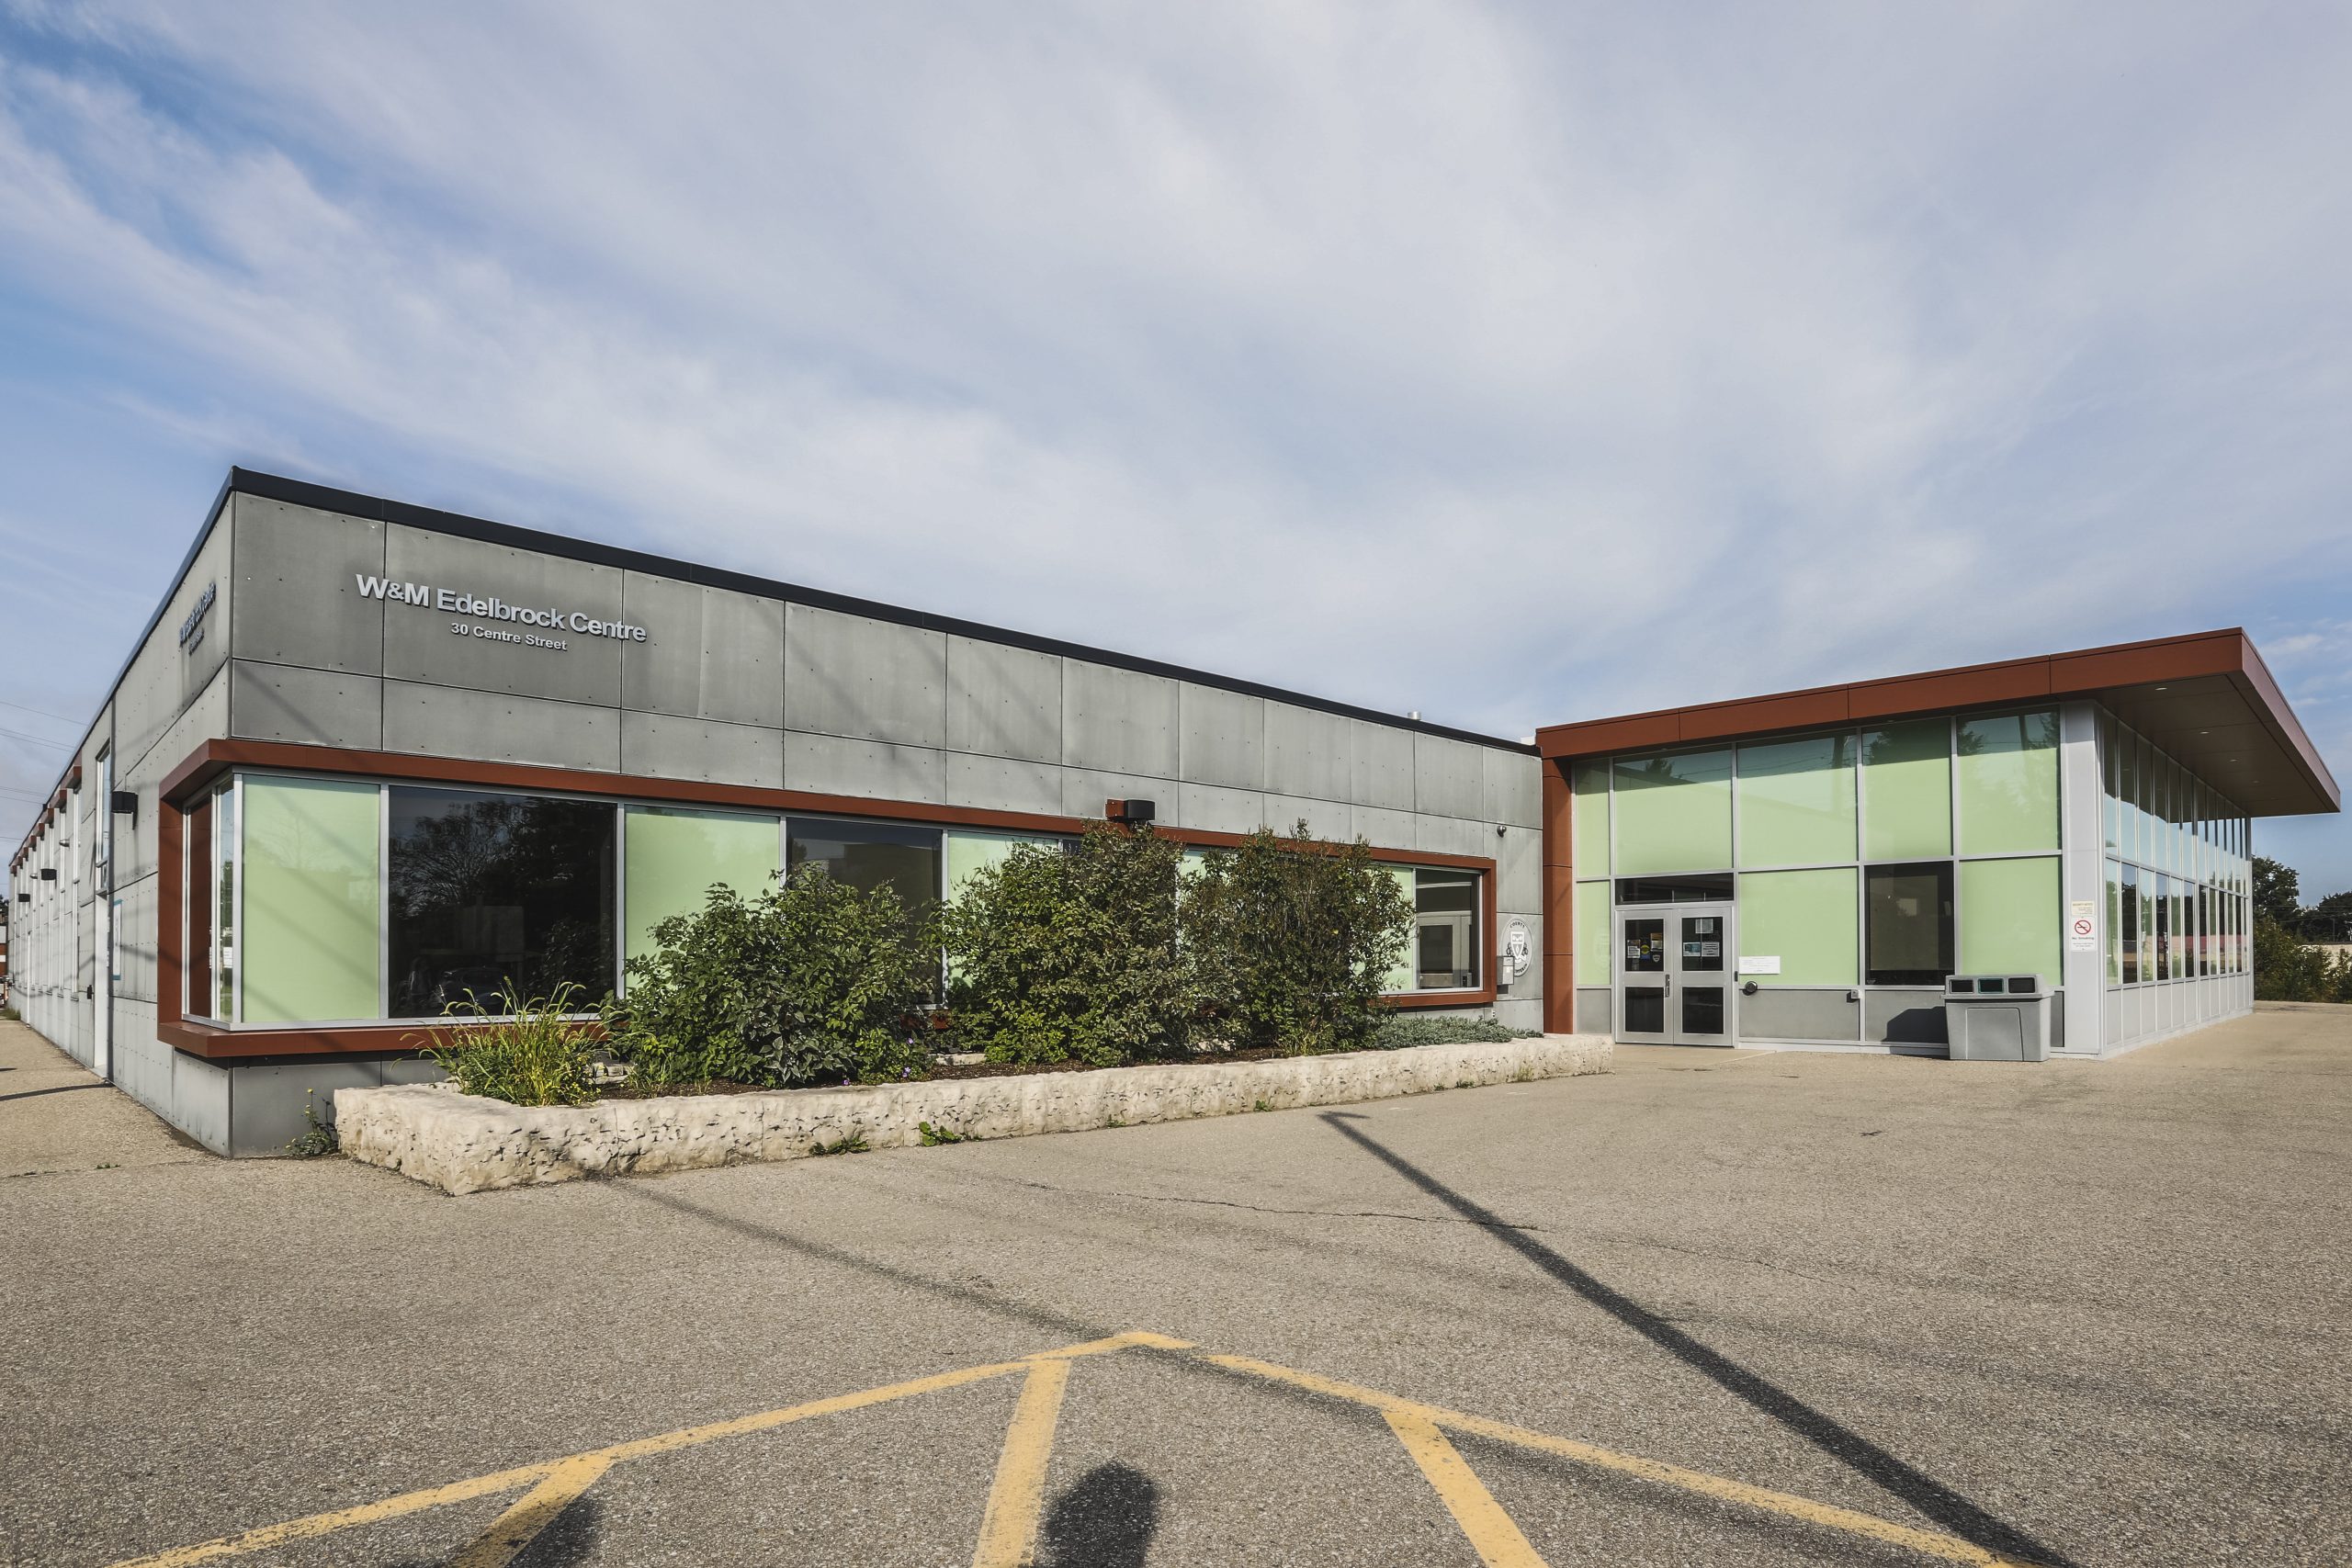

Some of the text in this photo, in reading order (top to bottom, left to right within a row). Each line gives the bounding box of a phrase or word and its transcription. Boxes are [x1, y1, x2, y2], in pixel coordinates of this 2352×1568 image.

[356, 573, 647, 642] W&M Edelbrock Centre
[451, 622, 568, 651] 30 Centre Street
